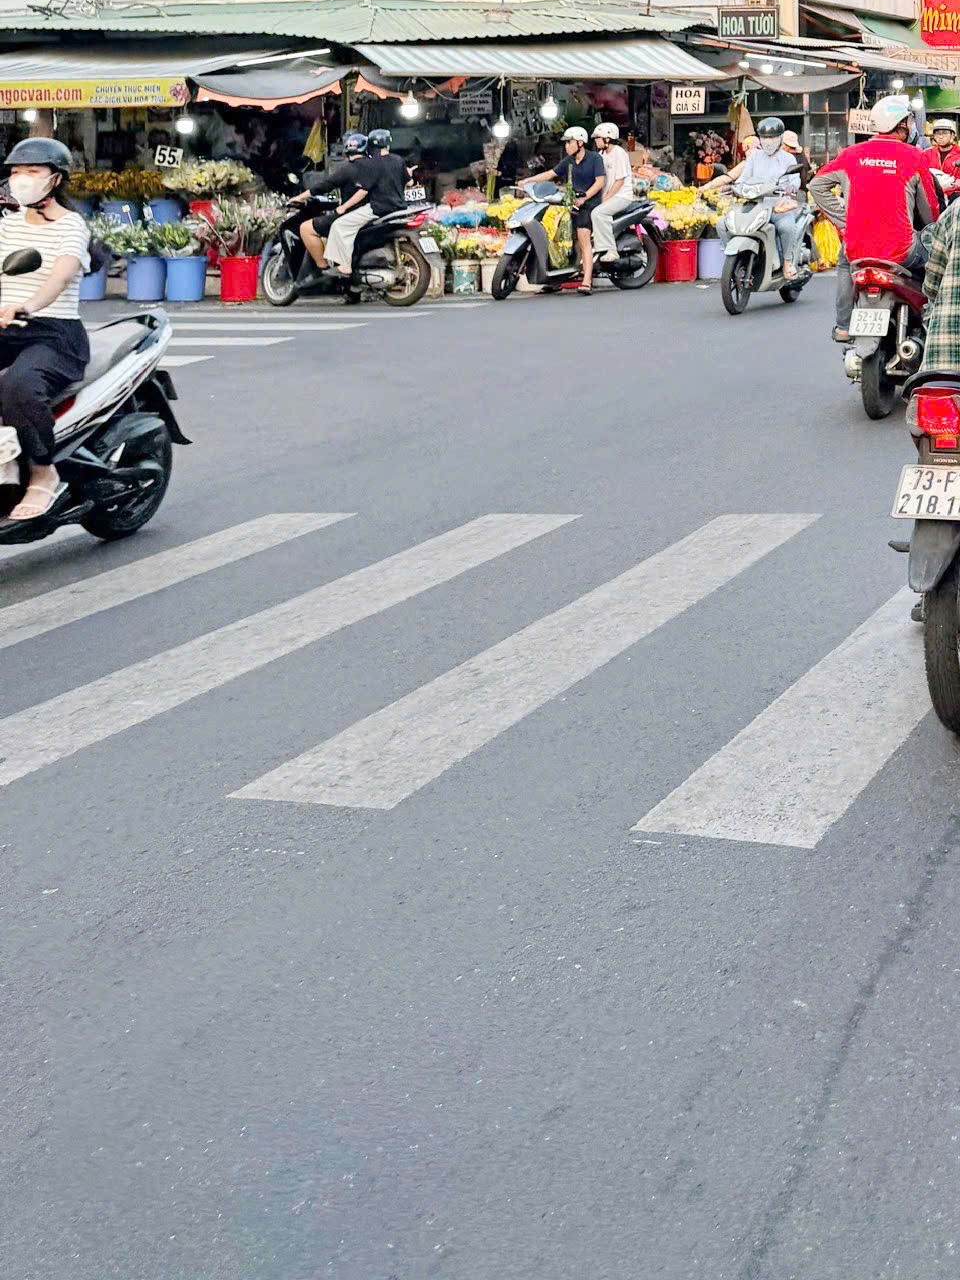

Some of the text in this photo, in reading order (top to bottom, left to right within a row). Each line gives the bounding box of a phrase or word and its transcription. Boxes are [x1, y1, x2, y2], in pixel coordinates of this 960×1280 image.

[722, 12, 774, 35] HOA TƯƠI
[676, 89, 701, 99] HOA
[675, 99, 689, 112] GIÁ
[859, 158, 897, 169] viettel
